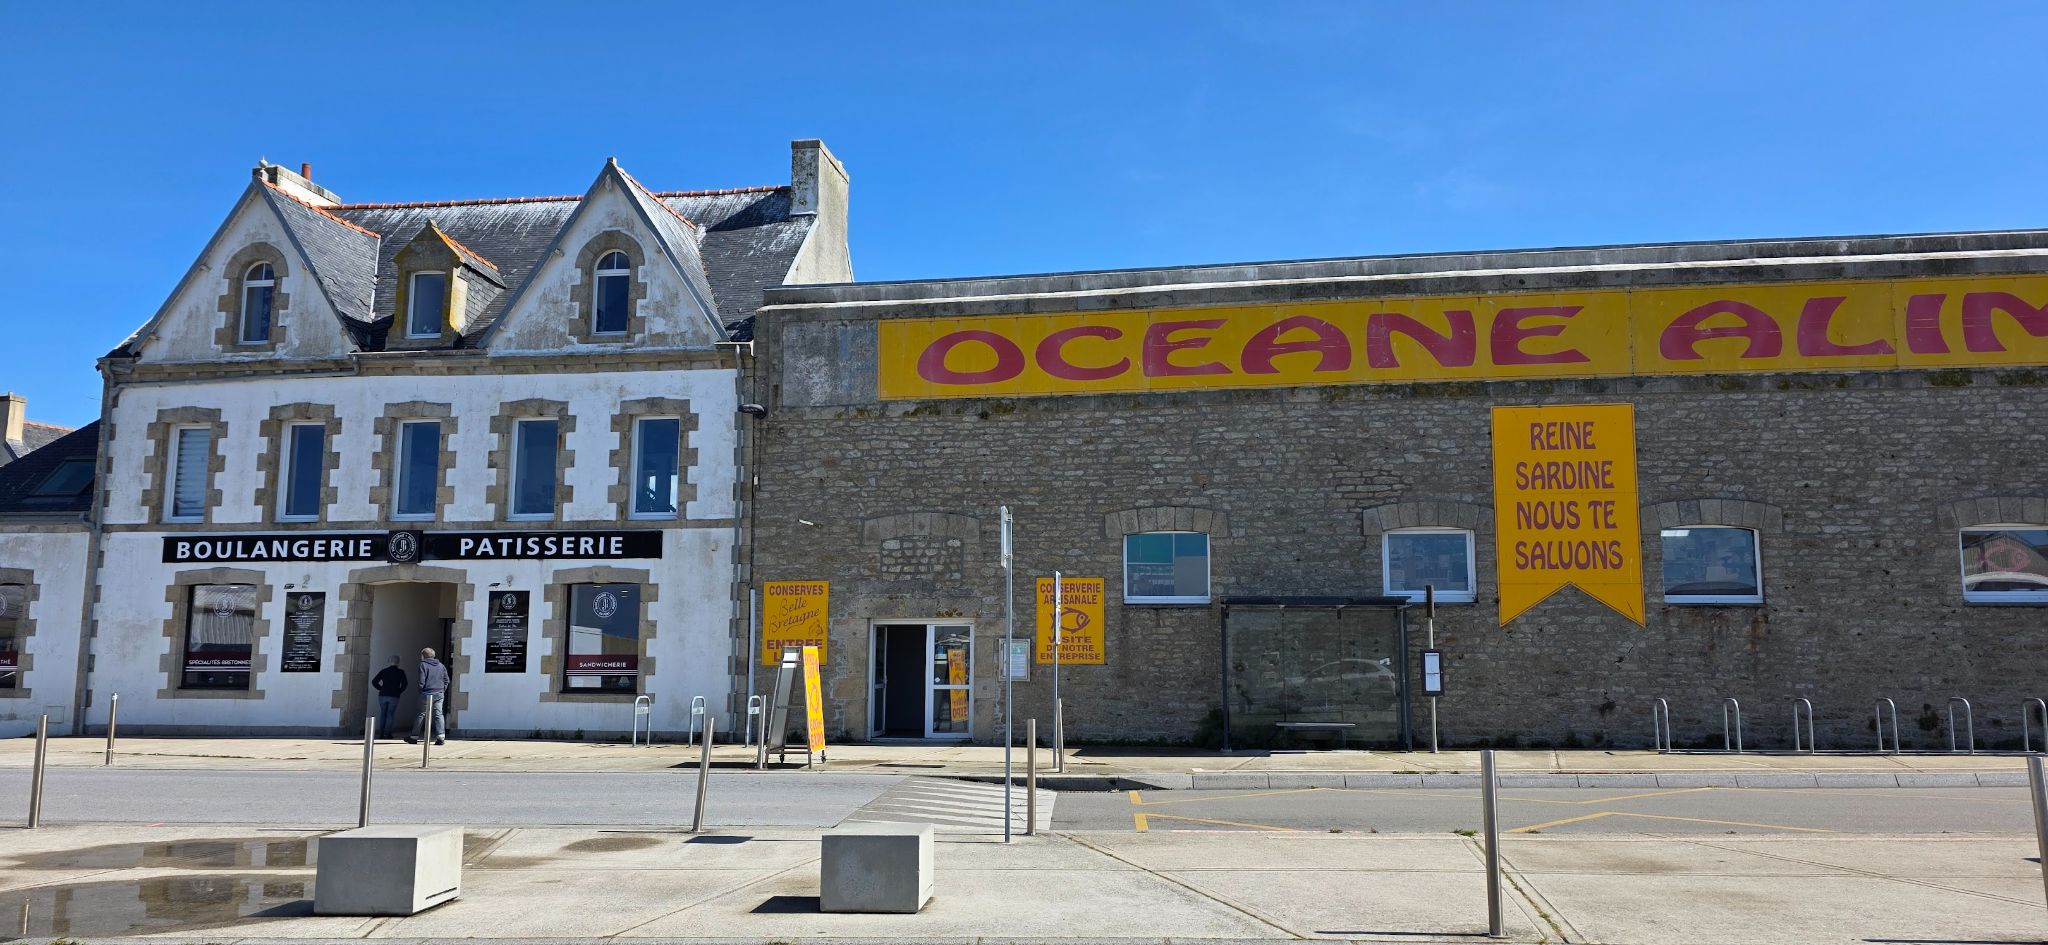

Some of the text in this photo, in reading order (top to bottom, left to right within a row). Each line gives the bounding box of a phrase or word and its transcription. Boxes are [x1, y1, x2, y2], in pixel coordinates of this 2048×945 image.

[916, 304, 1590, 385] OCEANE
[1530, 421, 1597, 450] REINE
[1515, 460, 1615, 490] SARDINE
[1516, 500, 1618, 530] NOUS TE
[175, 539, 372, 560] BOULANGERIE
[459, 536, 624, 557] PATISSERIE
[1515, 540, 1624, 570] SALUONS
[769, 584, 824, 596] CONSERVES
[1040, 583, 1101, 594] COSERVERIE
[1044, 594, 1098, 605] ARISANALE
[780, 597, 806, 617] Belle
[768, 608, 820, 634] Bretagne
[1048, 636, 1092, 644] VSITE
[1062, 644, 1095, 652] NOTRE
